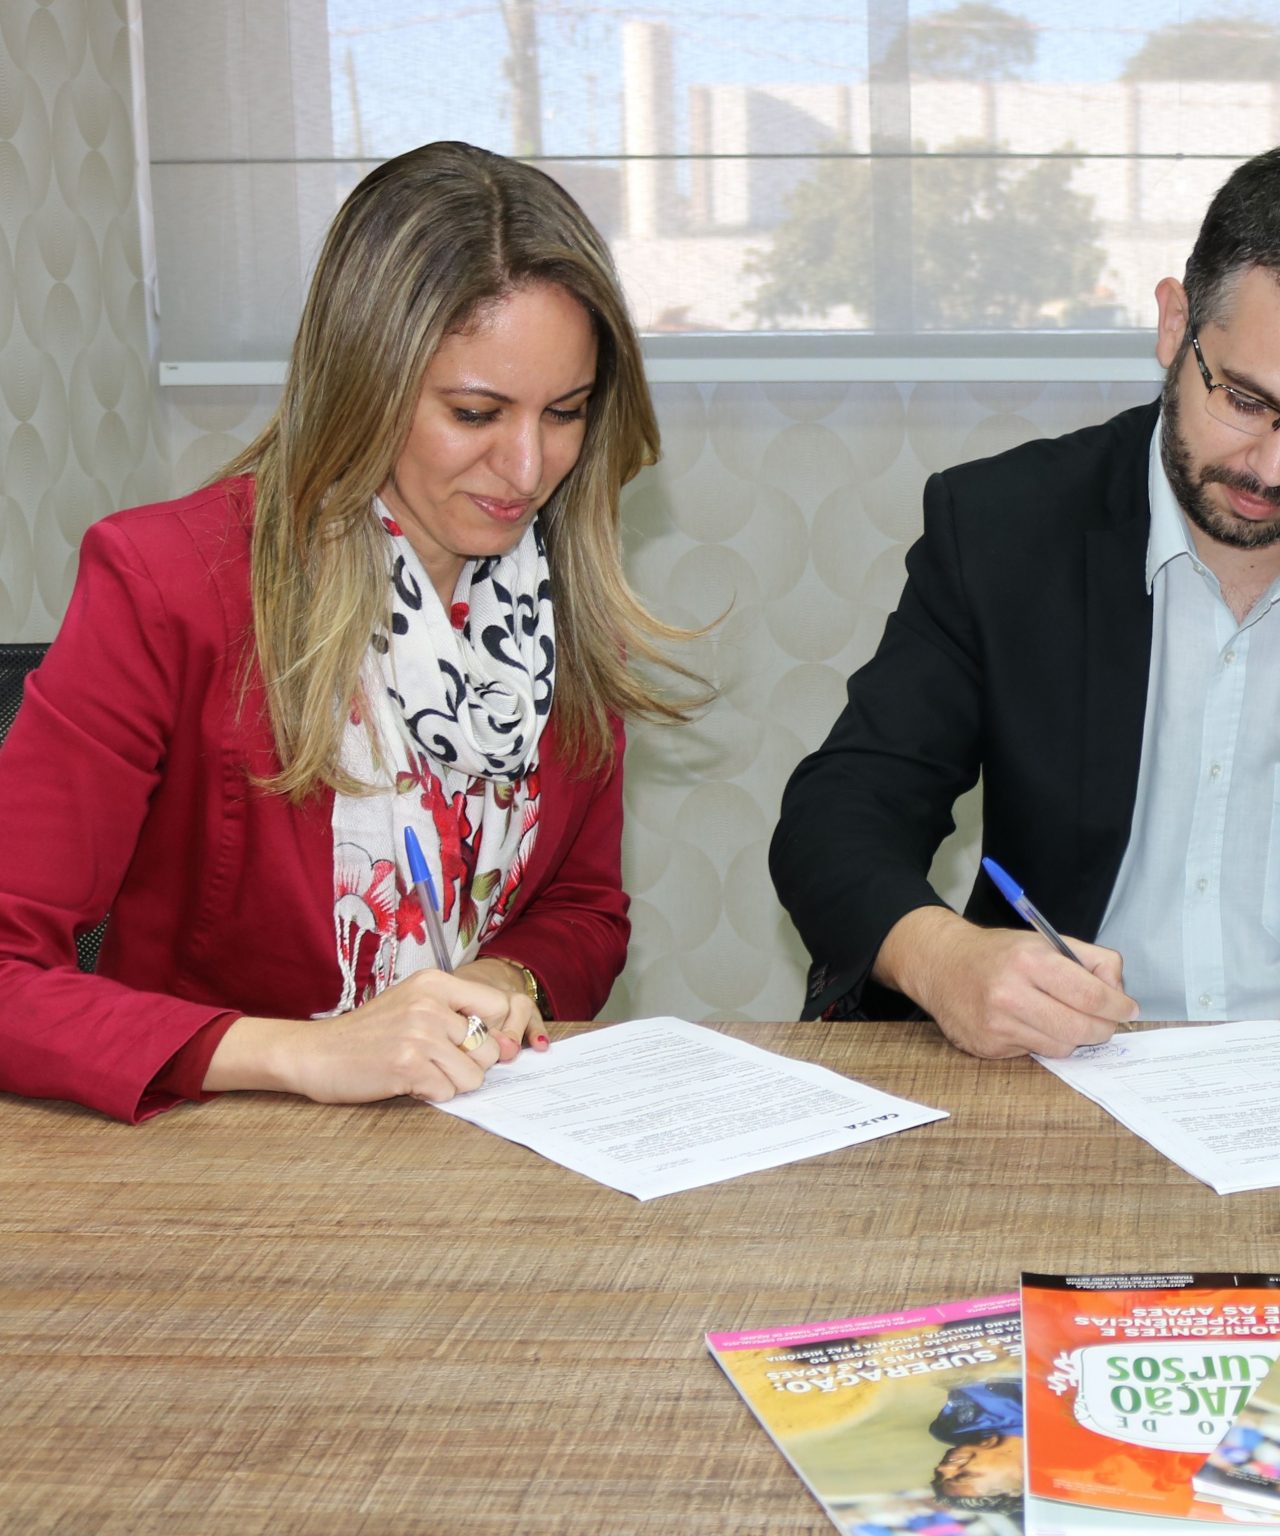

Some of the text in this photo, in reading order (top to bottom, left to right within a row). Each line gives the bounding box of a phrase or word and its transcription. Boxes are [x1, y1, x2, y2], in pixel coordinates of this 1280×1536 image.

[844, 1114, 899, 1130] CAIXA
[1131, 1306, 1215, 1317] APAES
[1222, 1306, 1257, 1315] AS
[984, 1319, 1020, 1330] EANO
[1073, 1316, 1257, 1328] EXPERIÊNCIAS
[986, 1327, 1005, 1335] DE
[1100, 1328, 1116, 1336] E
[862, 1336, 919, 1350] ENCANTA
[923, 1331, 985, 1348] INCLUSÃO
[825, 1346, 850, 1356] FAZ
[851, 1343, 862, 1351] E
[889, 1342, 922, 1353] PELO
[764, 1349, 825, 1362] HISTÓRIA
[765, 1333, 1023, 1381] DAS ESPECIAIS DAS APAES
[831, 1348, 887, 1361] ESPORTE
[809, 1356, 829, 1365] DO
[771, 1344, 1023, 1394] E SUPERAÇÃO:
[1115, 1416, 1157, 1433] DE
